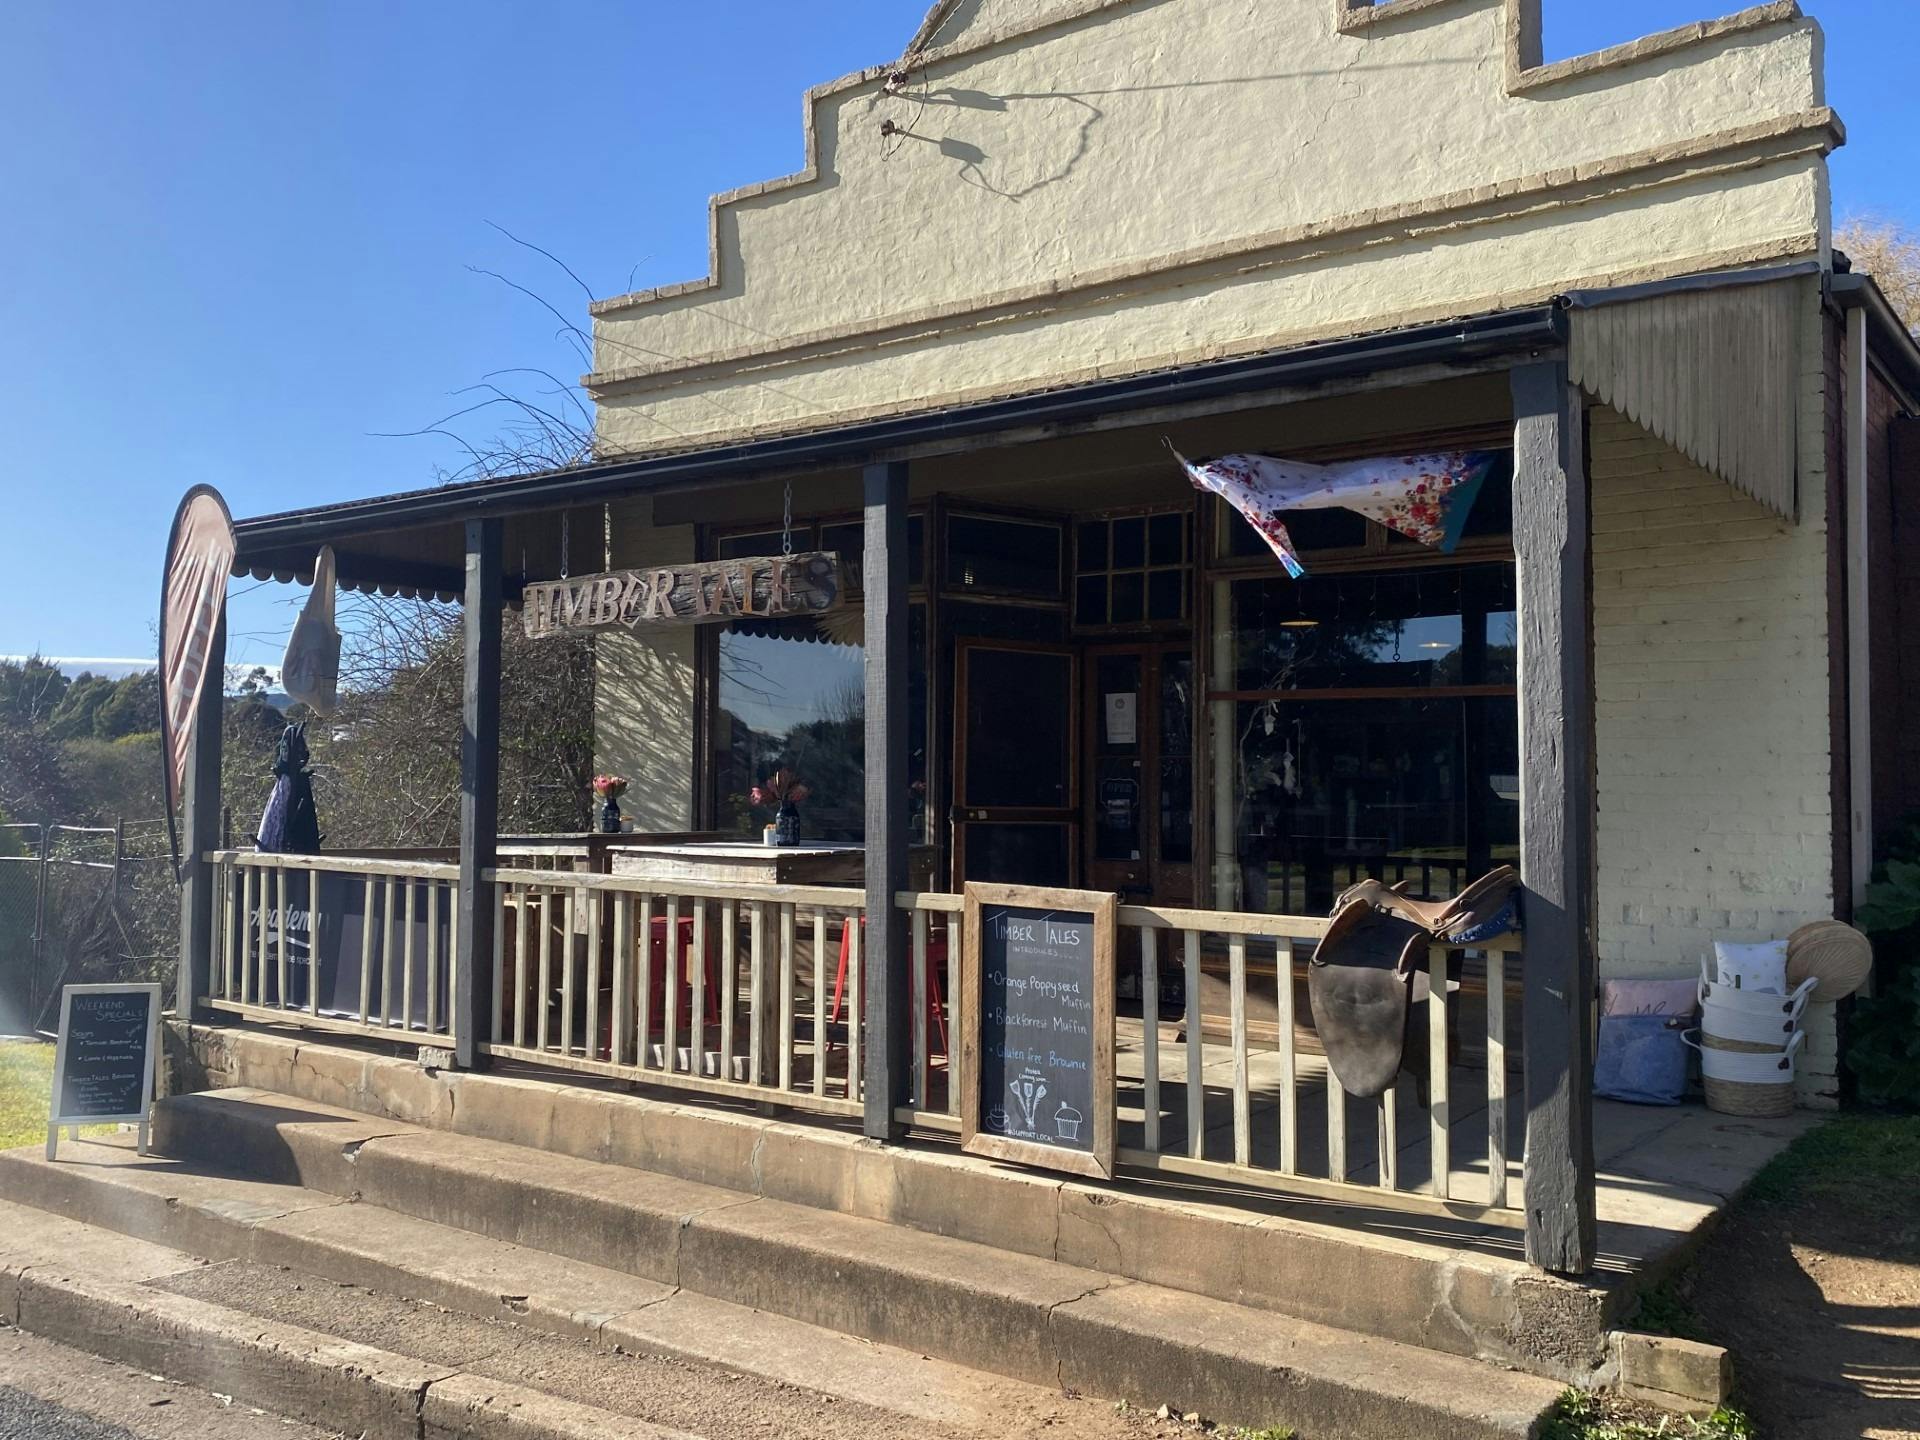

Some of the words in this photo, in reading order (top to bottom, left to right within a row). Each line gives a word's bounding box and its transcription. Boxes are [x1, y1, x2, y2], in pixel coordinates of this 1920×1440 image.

[525, 568, 677, 634] TIMBER
[692, 556, 838, 617] TALES
[986, 911, 1036, 942] TIMBER
[1039, 912, 1080, 945] TALES
[994, 971, 1027, 996] Orange
[1053, 1016, 1087, 1035] Muffin
[1049, 1050, 1086, 1070] Brownie
